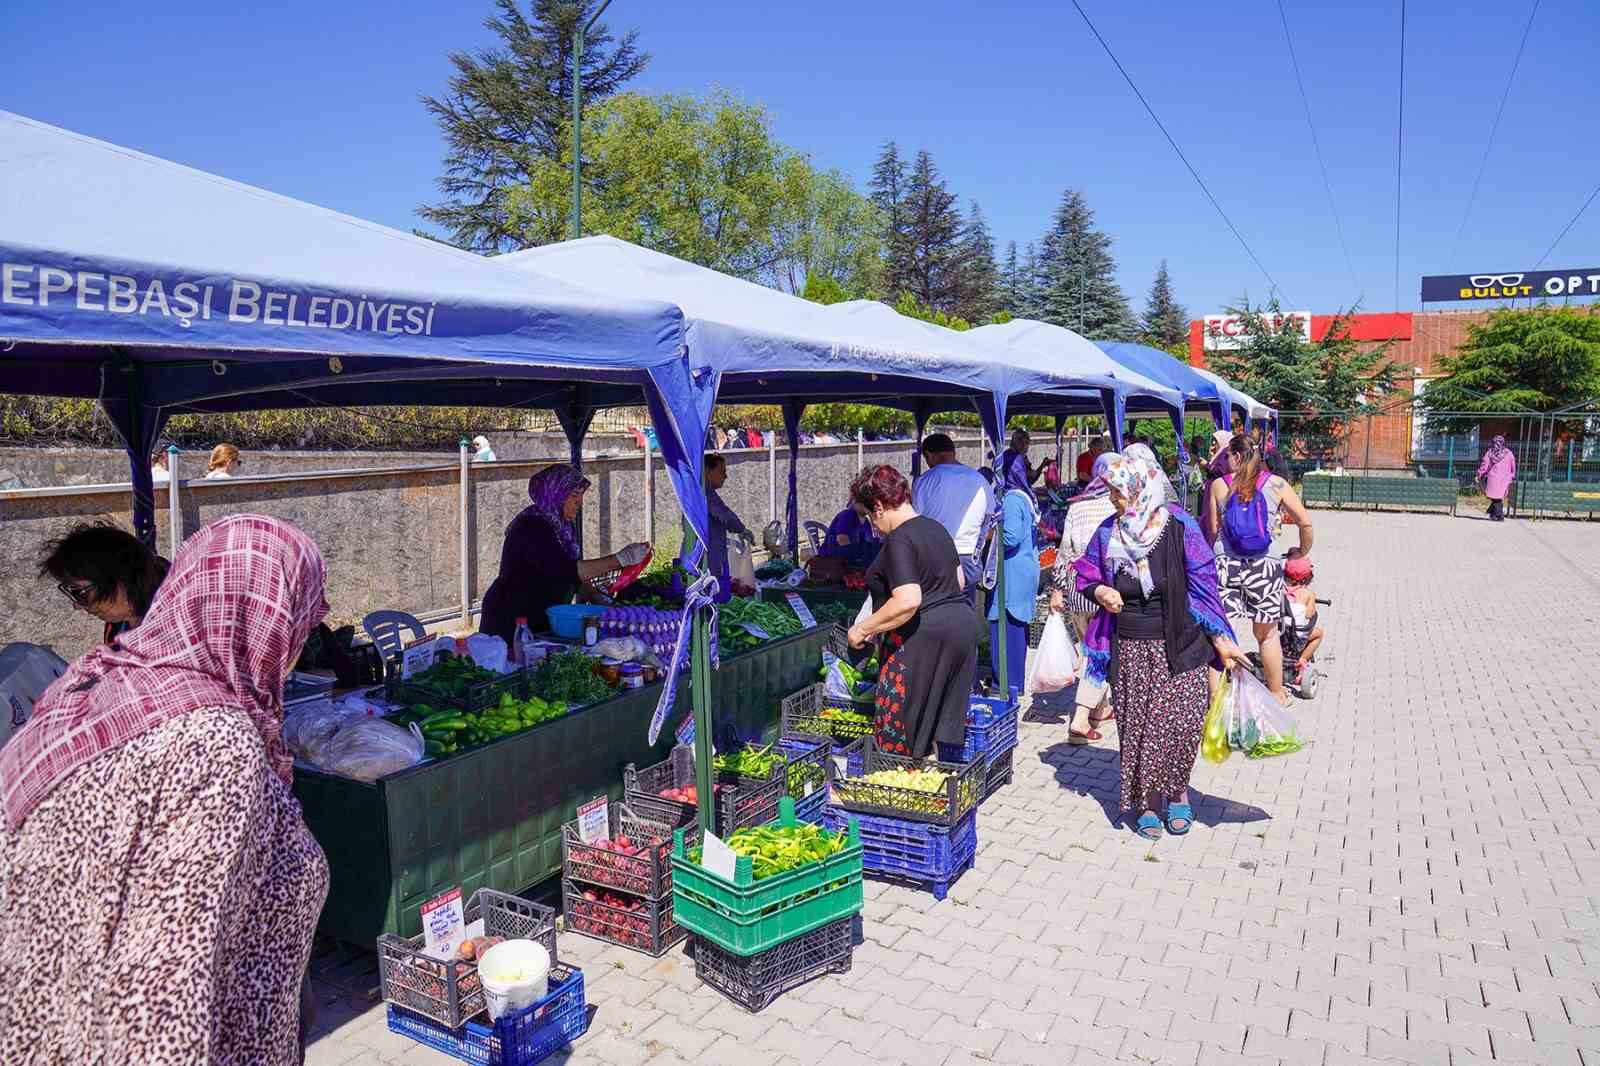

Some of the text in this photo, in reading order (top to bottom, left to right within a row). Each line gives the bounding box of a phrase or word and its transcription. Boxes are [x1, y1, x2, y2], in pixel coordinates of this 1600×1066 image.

[1460, 286, 1533, 298] BULUT
[228, 279, 437, 337] BELEDİYESİ
[1208, 315, 1305, 337] ECZE
